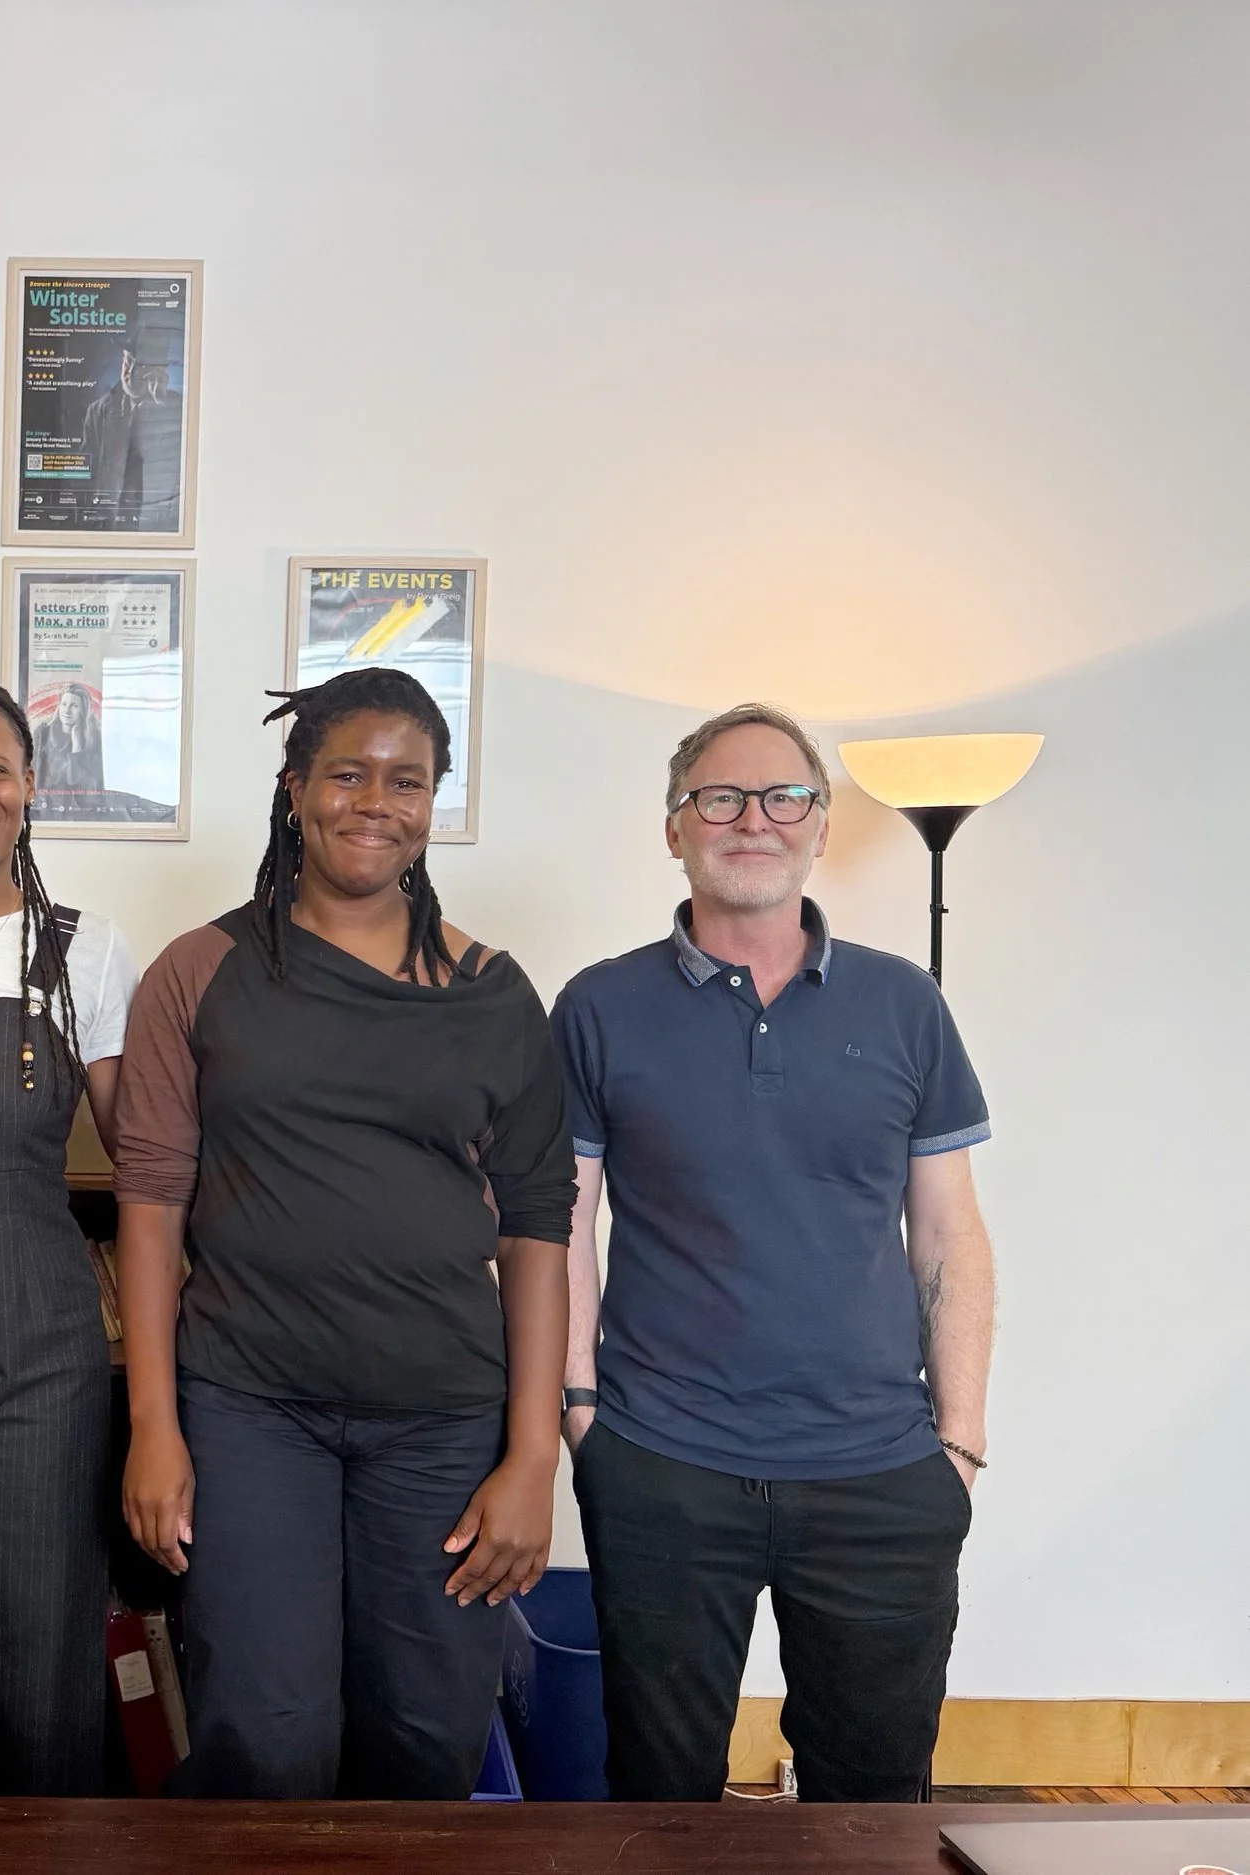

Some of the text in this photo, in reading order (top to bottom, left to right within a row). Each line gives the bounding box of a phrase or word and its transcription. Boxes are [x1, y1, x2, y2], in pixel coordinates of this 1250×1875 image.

[29, 289, 99, 307] Winter
[49, 307, 127, 326] Solstice
[318, 572, 453, 590] THE EVENTS
[439, 593, 461, 601] Greig
[34, 602, 110, 613] Letters From
[34, 616, 63, 628] Max,
[66, 619, 73, 627] a
[76, 616, 109, 627] ritual
